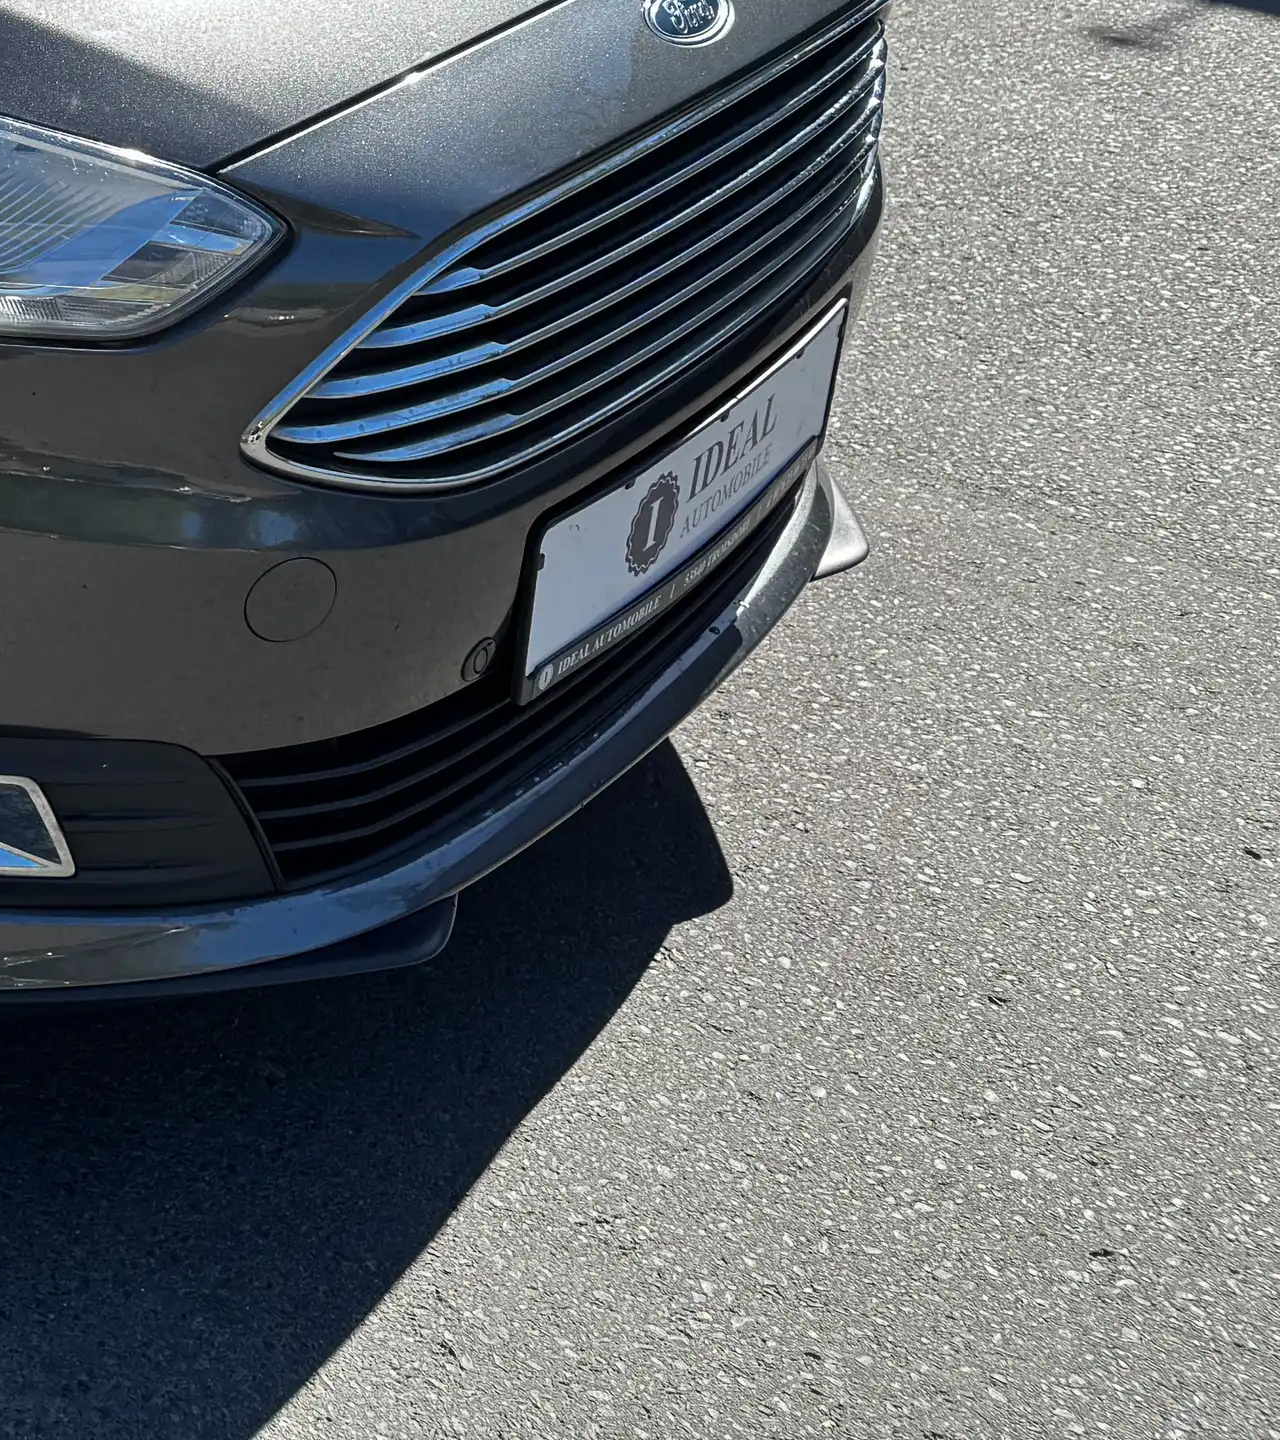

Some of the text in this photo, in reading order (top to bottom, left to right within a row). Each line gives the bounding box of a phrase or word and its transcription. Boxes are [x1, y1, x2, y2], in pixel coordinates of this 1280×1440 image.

[679, 443, 773, 540] AUTOMOBILE
[686, 393, 778, 503] IDEAL
[558, 643, 590, 675] IDEAL
[592, 594, 662, 652] AUTOMOBILE
